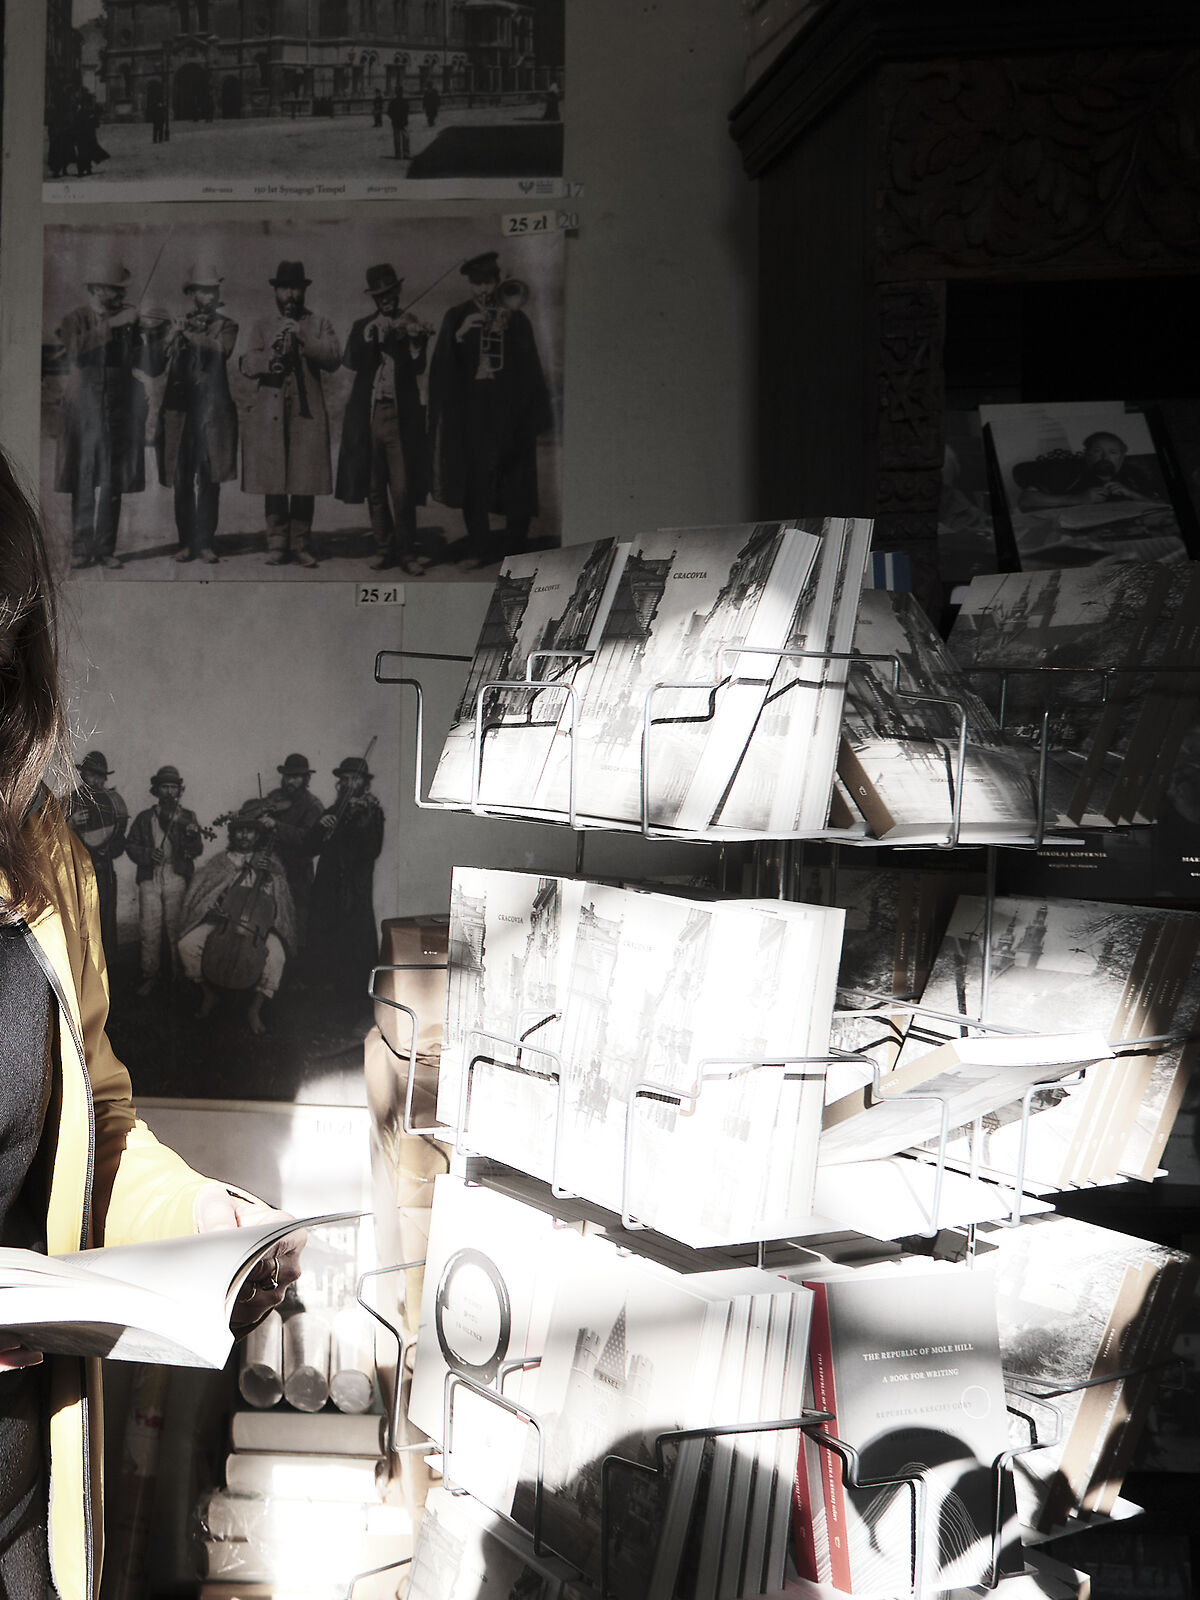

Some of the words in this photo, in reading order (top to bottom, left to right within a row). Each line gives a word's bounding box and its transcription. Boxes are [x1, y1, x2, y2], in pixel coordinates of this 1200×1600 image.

[316, 184, 345, 195] Tempel
[509, 217, 529, 232] 25
[560, 211, 579, 229] 20
[673, 566, 708, 580] CRACOVIA
[360, 588, 379, 603] 25
[862, 1352, 881, 1361] THE
[881, 1348, 919, 1360] REPUBLIC
[919, 1347, 930, 1355] OF
[931, 1344, 954, 1354] MOLE
[954, 1342, 975, 1352] HILL
[882, 1375, 889, 1384] A
[889, 1373, 910, 1383] BOOK
[910, 1372, 926, 1381] FOR
[925, 1368, 960, 1379] WRITING
